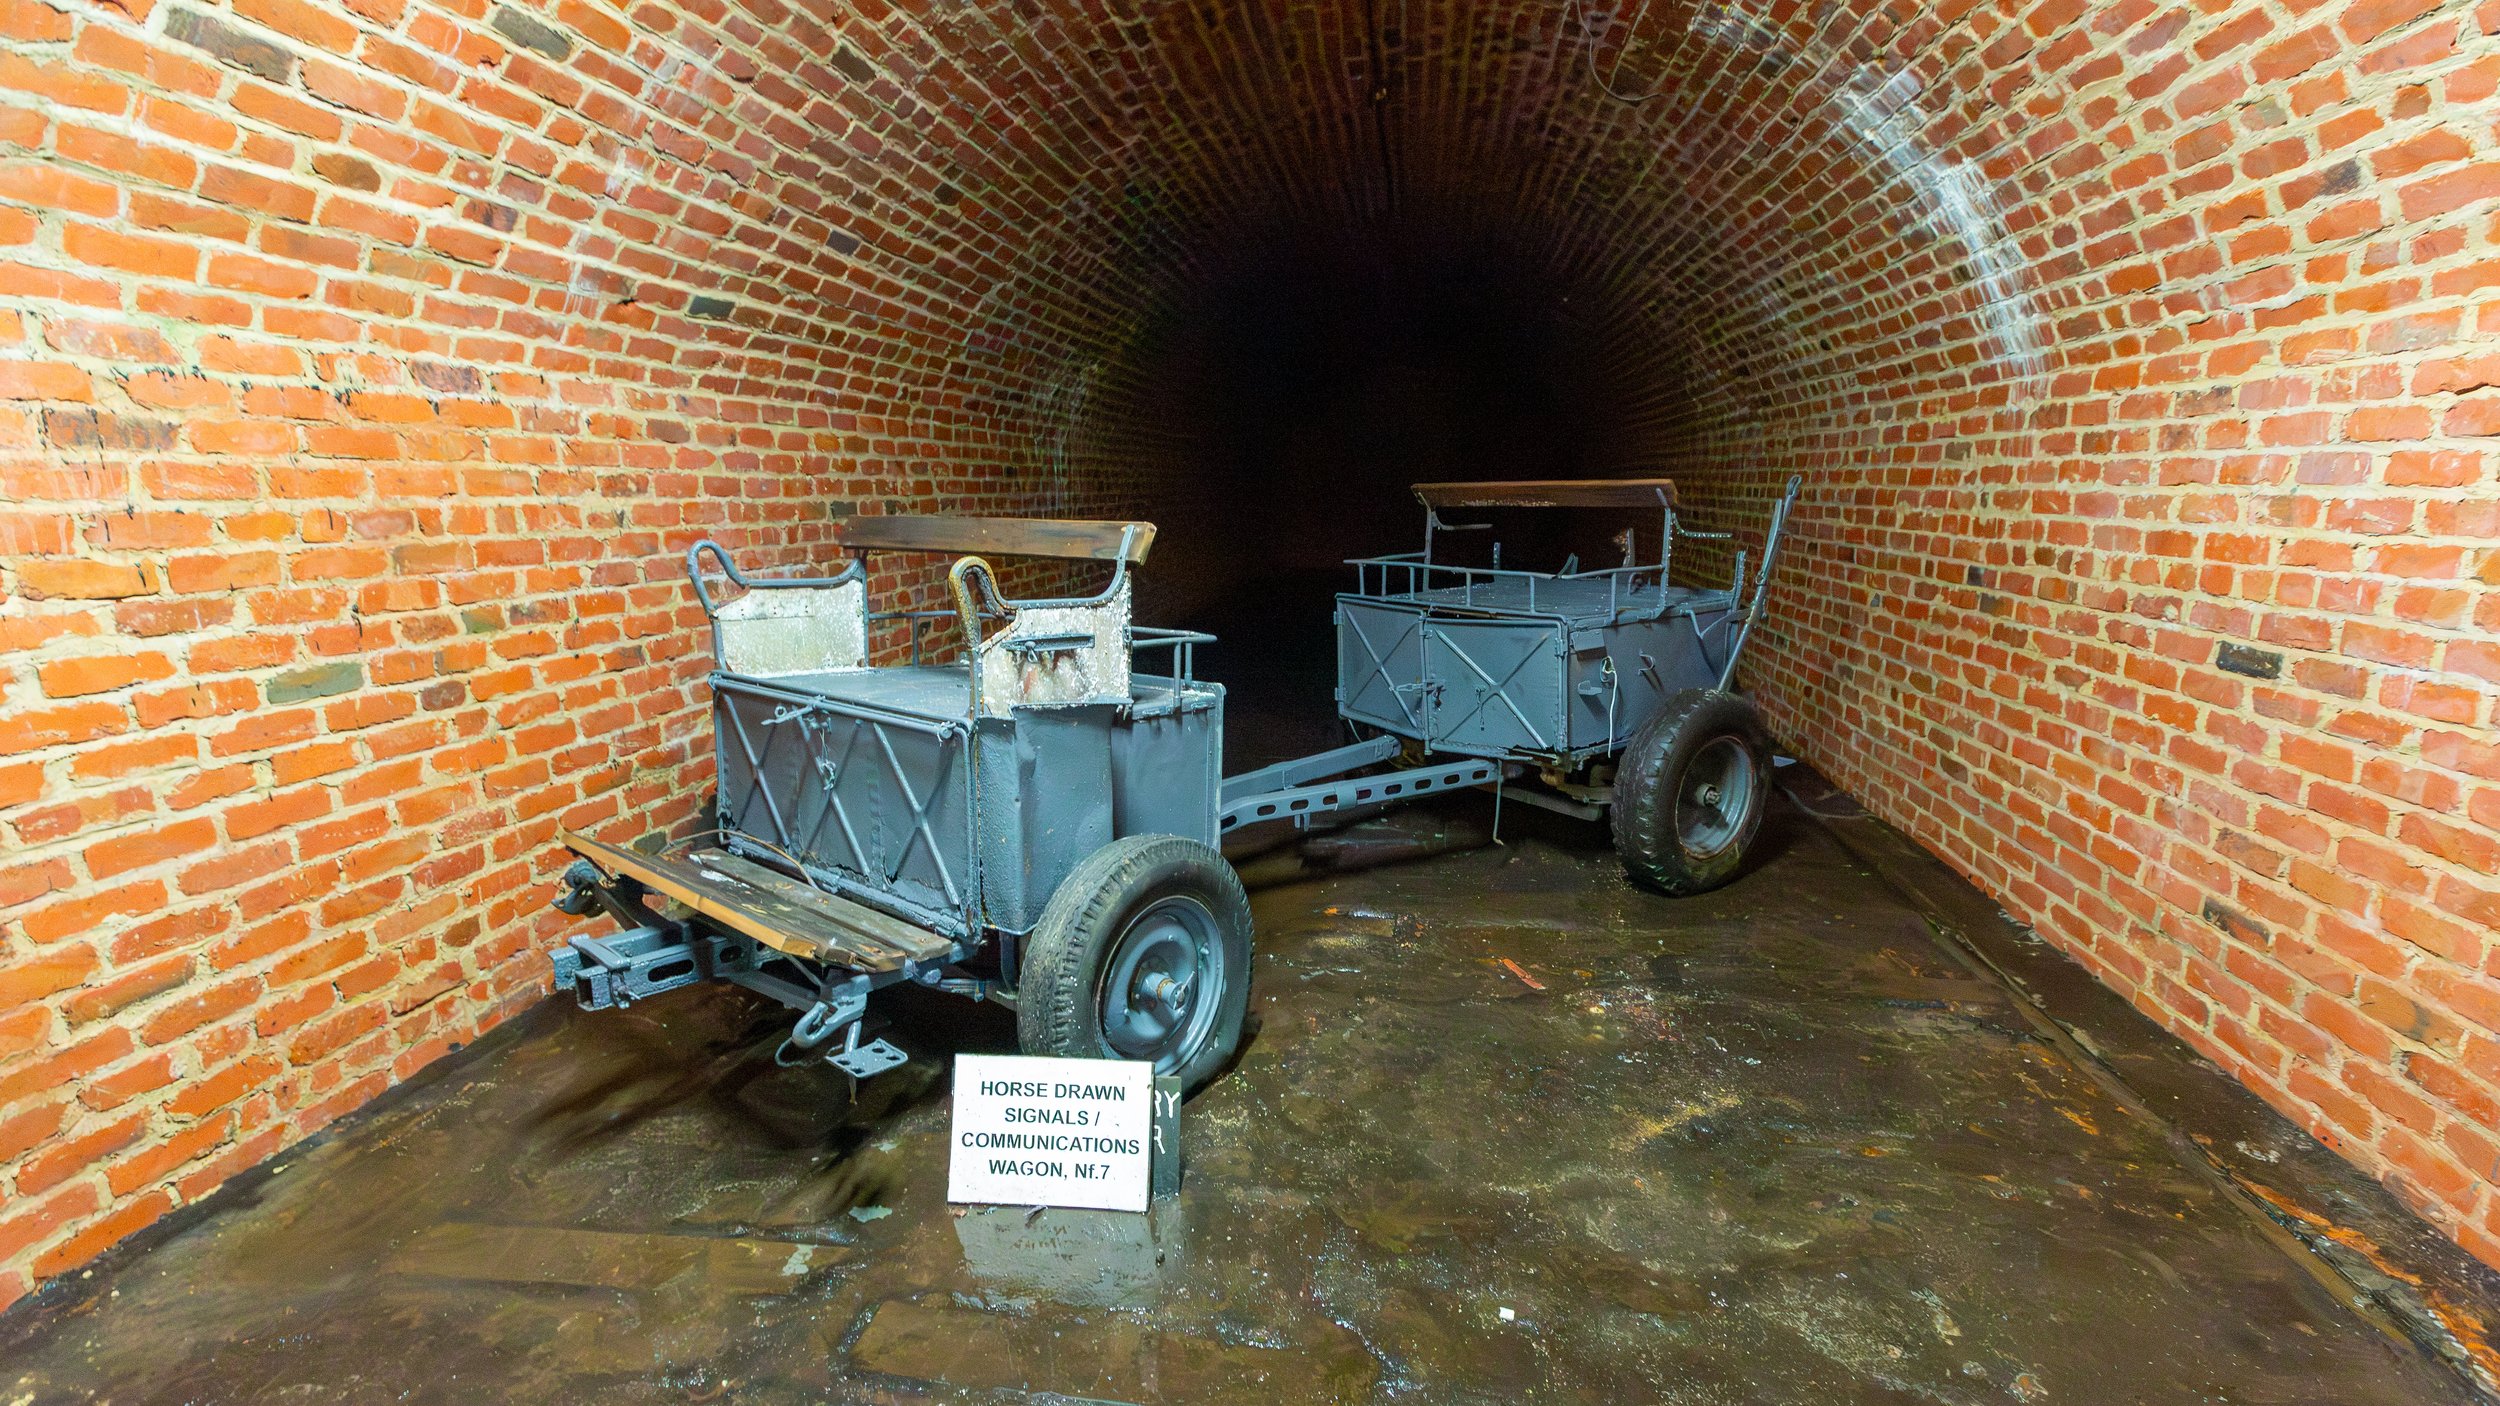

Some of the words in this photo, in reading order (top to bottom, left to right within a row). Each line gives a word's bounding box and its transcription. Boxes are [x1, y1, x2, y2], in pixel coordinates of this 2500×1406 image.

[981, 1081, 1047, 1097] HORSE
[1055, 1084, 1124, 1101] DRAWN
[1005, 1108, 1088, 1125] SIGNALS
[1094, 1111, 1101, 1127] /
[962, 1133, 1139, 1154] COMMUNICATIONS
[989, 1160, 1067, 1178] WAGON,
[1076, 1164, 1109, 1179] Nf.7
